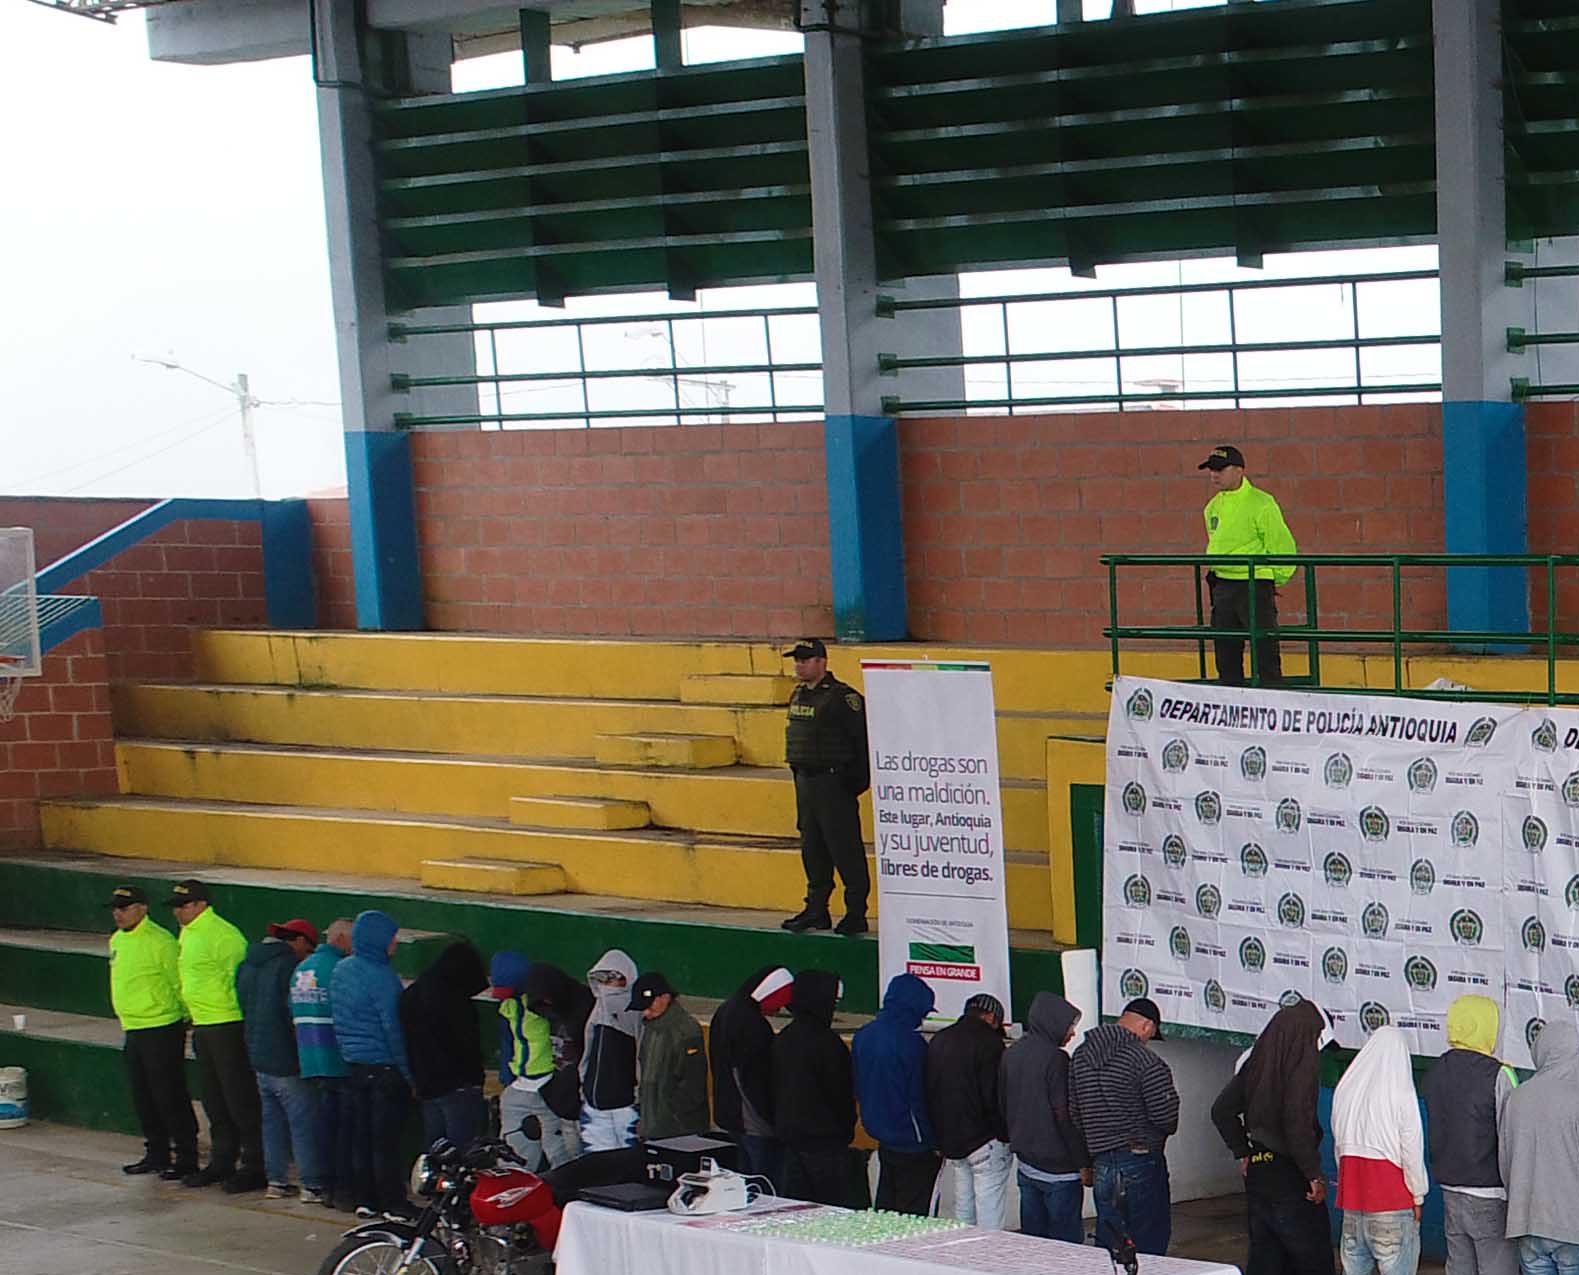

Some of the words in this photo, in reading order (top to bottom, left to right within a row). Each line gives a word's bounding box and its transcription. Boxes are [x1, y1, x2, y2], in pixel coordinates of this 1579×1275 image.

[1160, 698, 1277, 730] DEPARTAMENTO
[1282, 709, 1302, 732] DE
[1306, 708, 1363, 734] POLICÍA
[1366, 714, 1457, 742] ANTIOQUIA
[876, 750, 898, 770] Las
[902, 750, 956, 778] drogas
[958, 758, 988, 774] son
[878, 784, 904, 800] una
[908, 782, 990, 805] maldición.
[880, 810, 898, 824] Este
[900, 810, 934, 828] lugar,
[936, 812, 992, 830] Antioquia
[880, 832, 888, 856] y
[890, 833, 910, 850] su
[913, 830, 994, 858] juventud,
[880, 858, 918, 877] libres
[921, 860, 938, 878] de
[942, 862, 992, 884] drogas.
